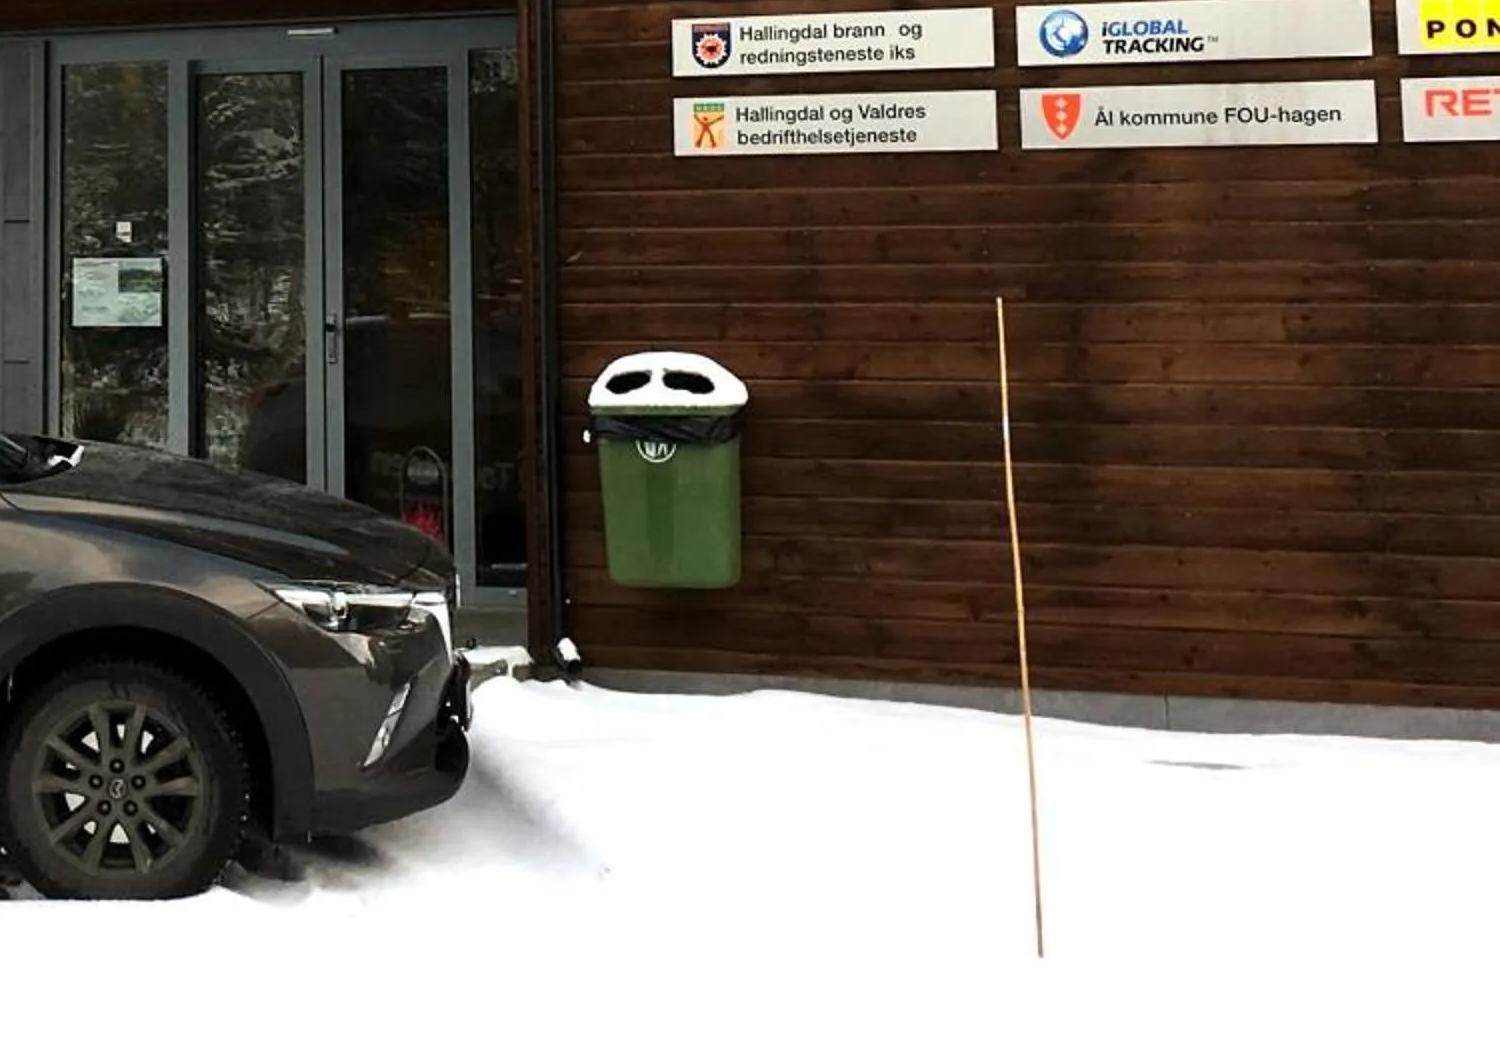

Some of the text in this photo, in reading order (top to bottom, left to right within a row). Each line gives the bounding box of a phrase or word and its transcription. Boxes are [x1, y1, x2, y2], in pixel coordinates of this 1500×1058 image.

[740, 23, 923, 42] Hallingdal brann og
[1101, 19, 1189, 37] iGLOBAL
[1102, 36, 1205, 54] TRACKING
[740, 45, 916, 66] redningsteneste iks
[1424, 88, 1500, 117] RE
[735, 103, 927, 124] Hallingdal og Valdres
[1119, 110, 1219, 126] kommune
[1224, 106, 1342, 126] FOU-hagen
[737, 128, 918, 147] bedrifthelsetjeneste
